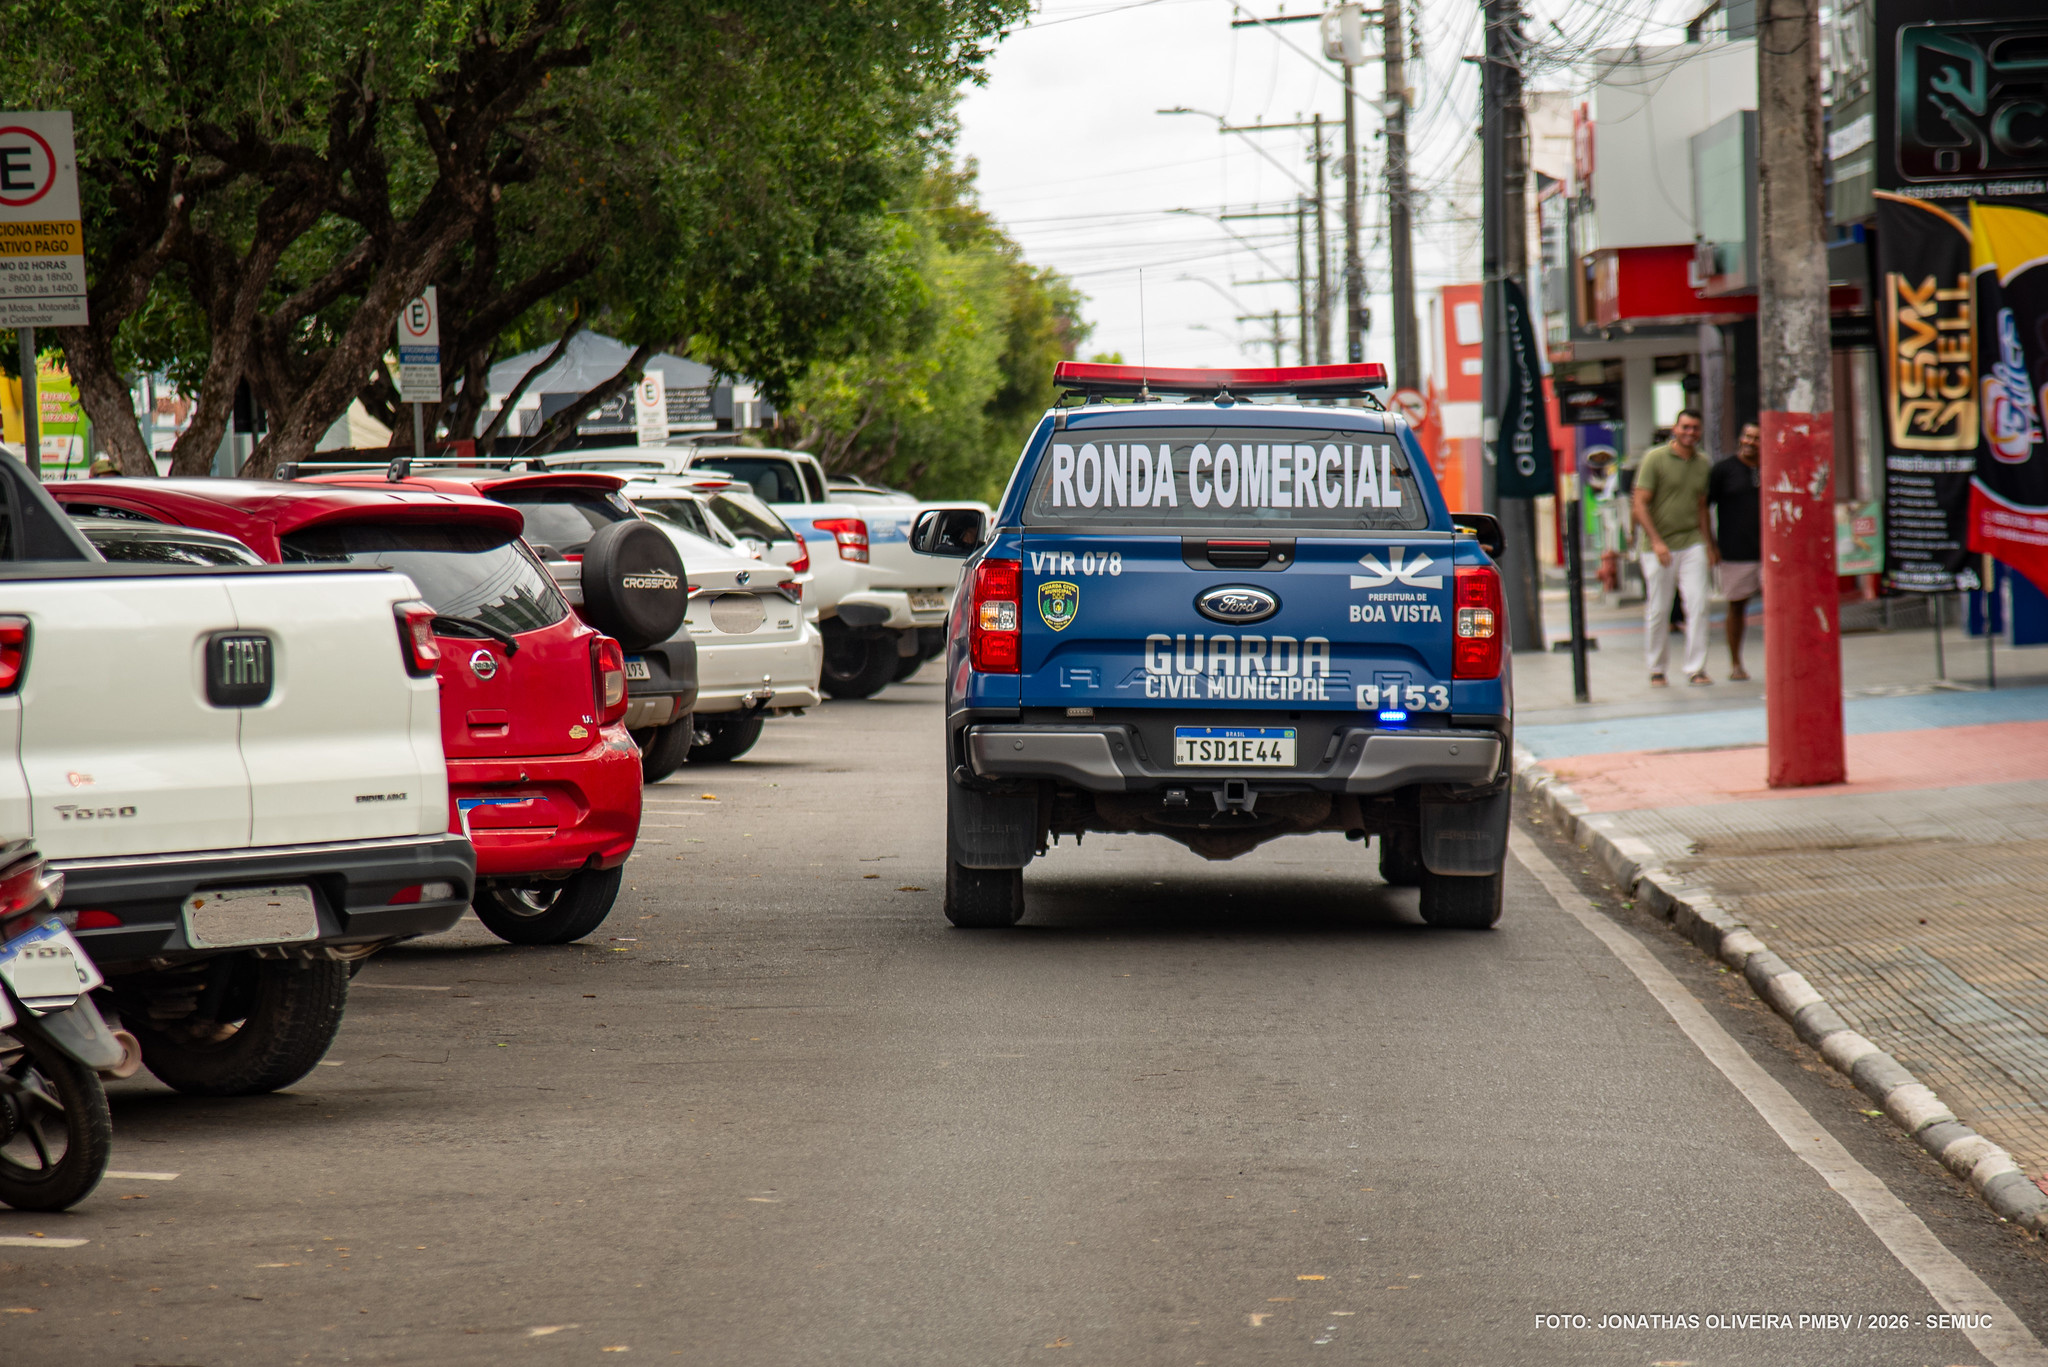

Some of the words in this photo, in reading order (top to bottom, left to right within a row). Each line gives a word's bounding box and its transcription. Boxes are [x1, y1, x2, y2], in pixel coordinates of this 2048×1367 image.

[0, 146, 35, 190] E
[35, 240, 69, 252] PAGO
[18, 261, 29, 270] 02
[32, 260, 67, 270] HORAS
[8, 273, 30, 282] 8h00
[46, 272, 73, 281] 18h00
[14, 284, 36, 294] 8h00
[52, 283, 78, 293] 14h00
[38, 302, 81, 312] Motonetas
[9, 315, 53, 324] Ciclomotor
[412, 304, 424, 328] E
[1935, 272, 1971, 400] CELL
[645, 383, 655, 399] E
[1052, 443, 1178, 508] RONDA
[1189, 443, 1402, 509] COMERCIAL
[1030, 551, 1076, 576] VTR
[1082, 551, 1122, 576] 078
[622, 577, 678, 589] CROSSFOX
[1041, 583, 1062, 592] GUARDA
[1218, 595, 1258, 613] Ford
[1368, 593, 1415, 601] PREFEITURA
[1417, 593, 1427, 601] DE
[1349, 605, 1387, 622] BOA
[1390, 605, 1442, 622] VISTA
[223, 640, 267, 685] FIAT
[1144, 633, 1330, 678] GUARDA
[1145, 675, 1201, 699] CIVIL
[1207, 675, 1330, 701] MUNICIPAL
[1382, 684, 1450, 711] 153
[1177, 755, 1185, 763] BR
[1186, 740, 1281, 762] TSD1E44
[356, 792, 408, 803] ENDURANCE
